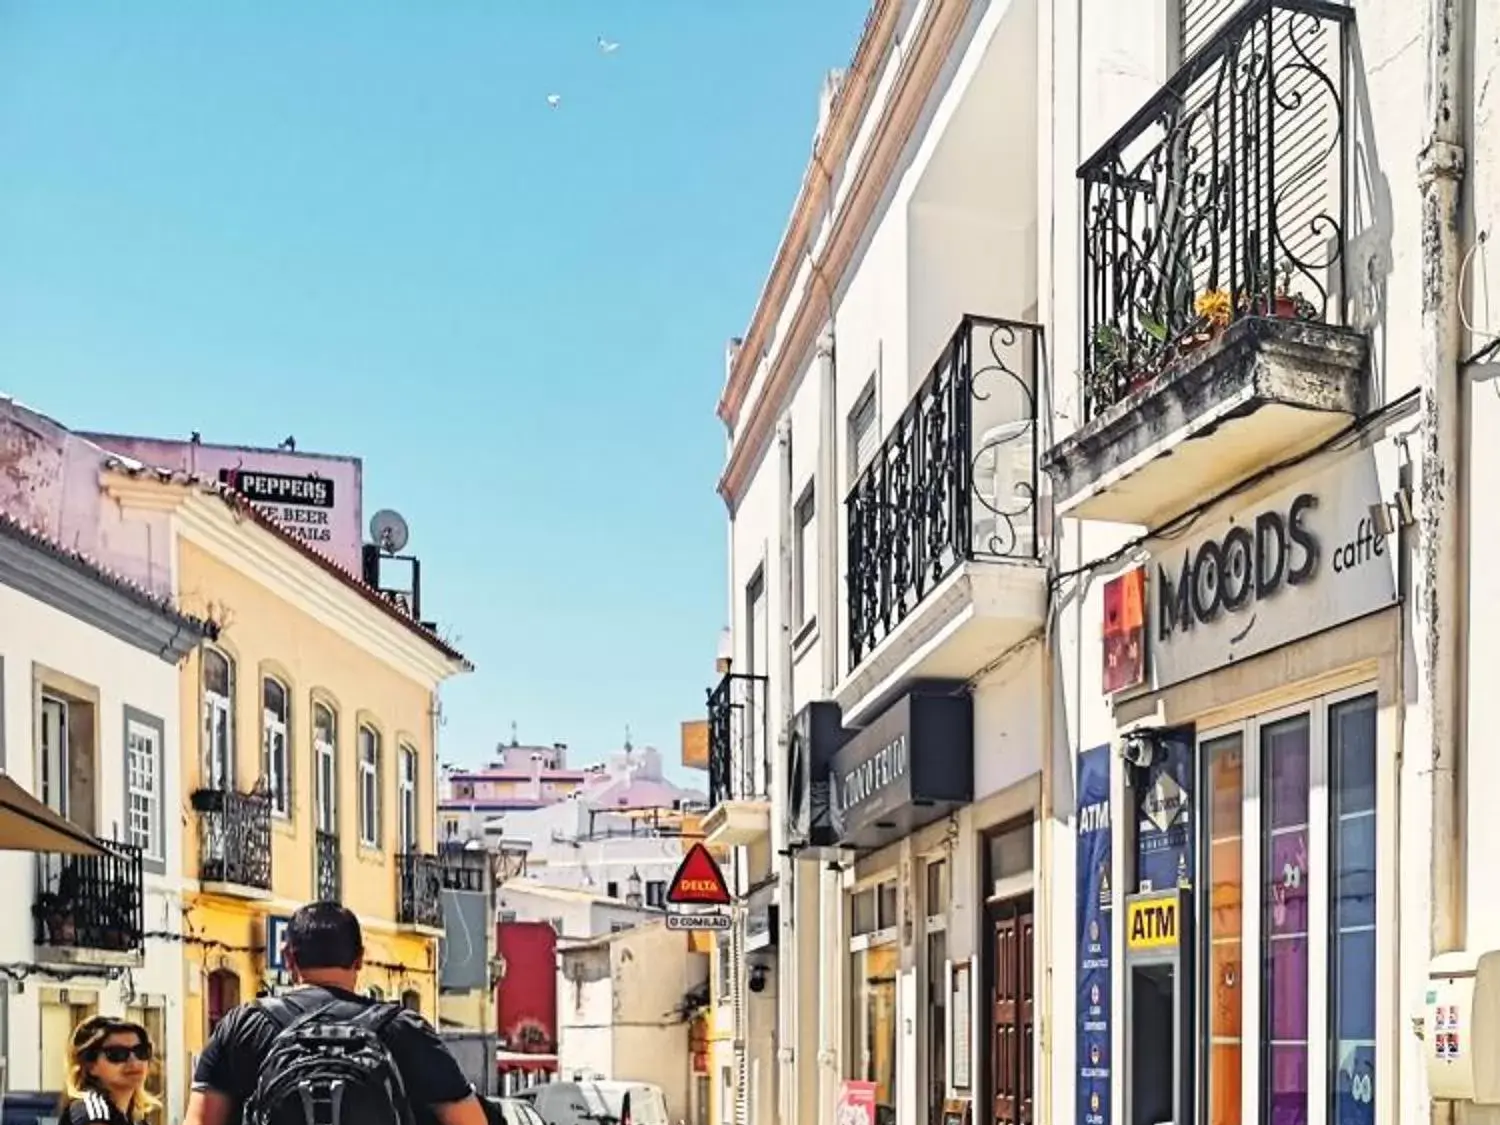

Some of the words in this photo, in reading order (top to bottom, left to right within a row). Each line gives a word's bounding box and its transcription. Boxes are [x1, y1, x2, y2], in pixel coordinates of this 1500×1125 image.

[243, 475, 327, 499] PEPPERS
[284, 507, 328, 525] BEER
[1158, 493, 1320, 642] MOODS
[1079, 800, 1110, 836] ATM
[680, 879, 719, 892] DELTA
[670, 917, 679, 927] O
[1131, 905, 1175, 941] ATM
